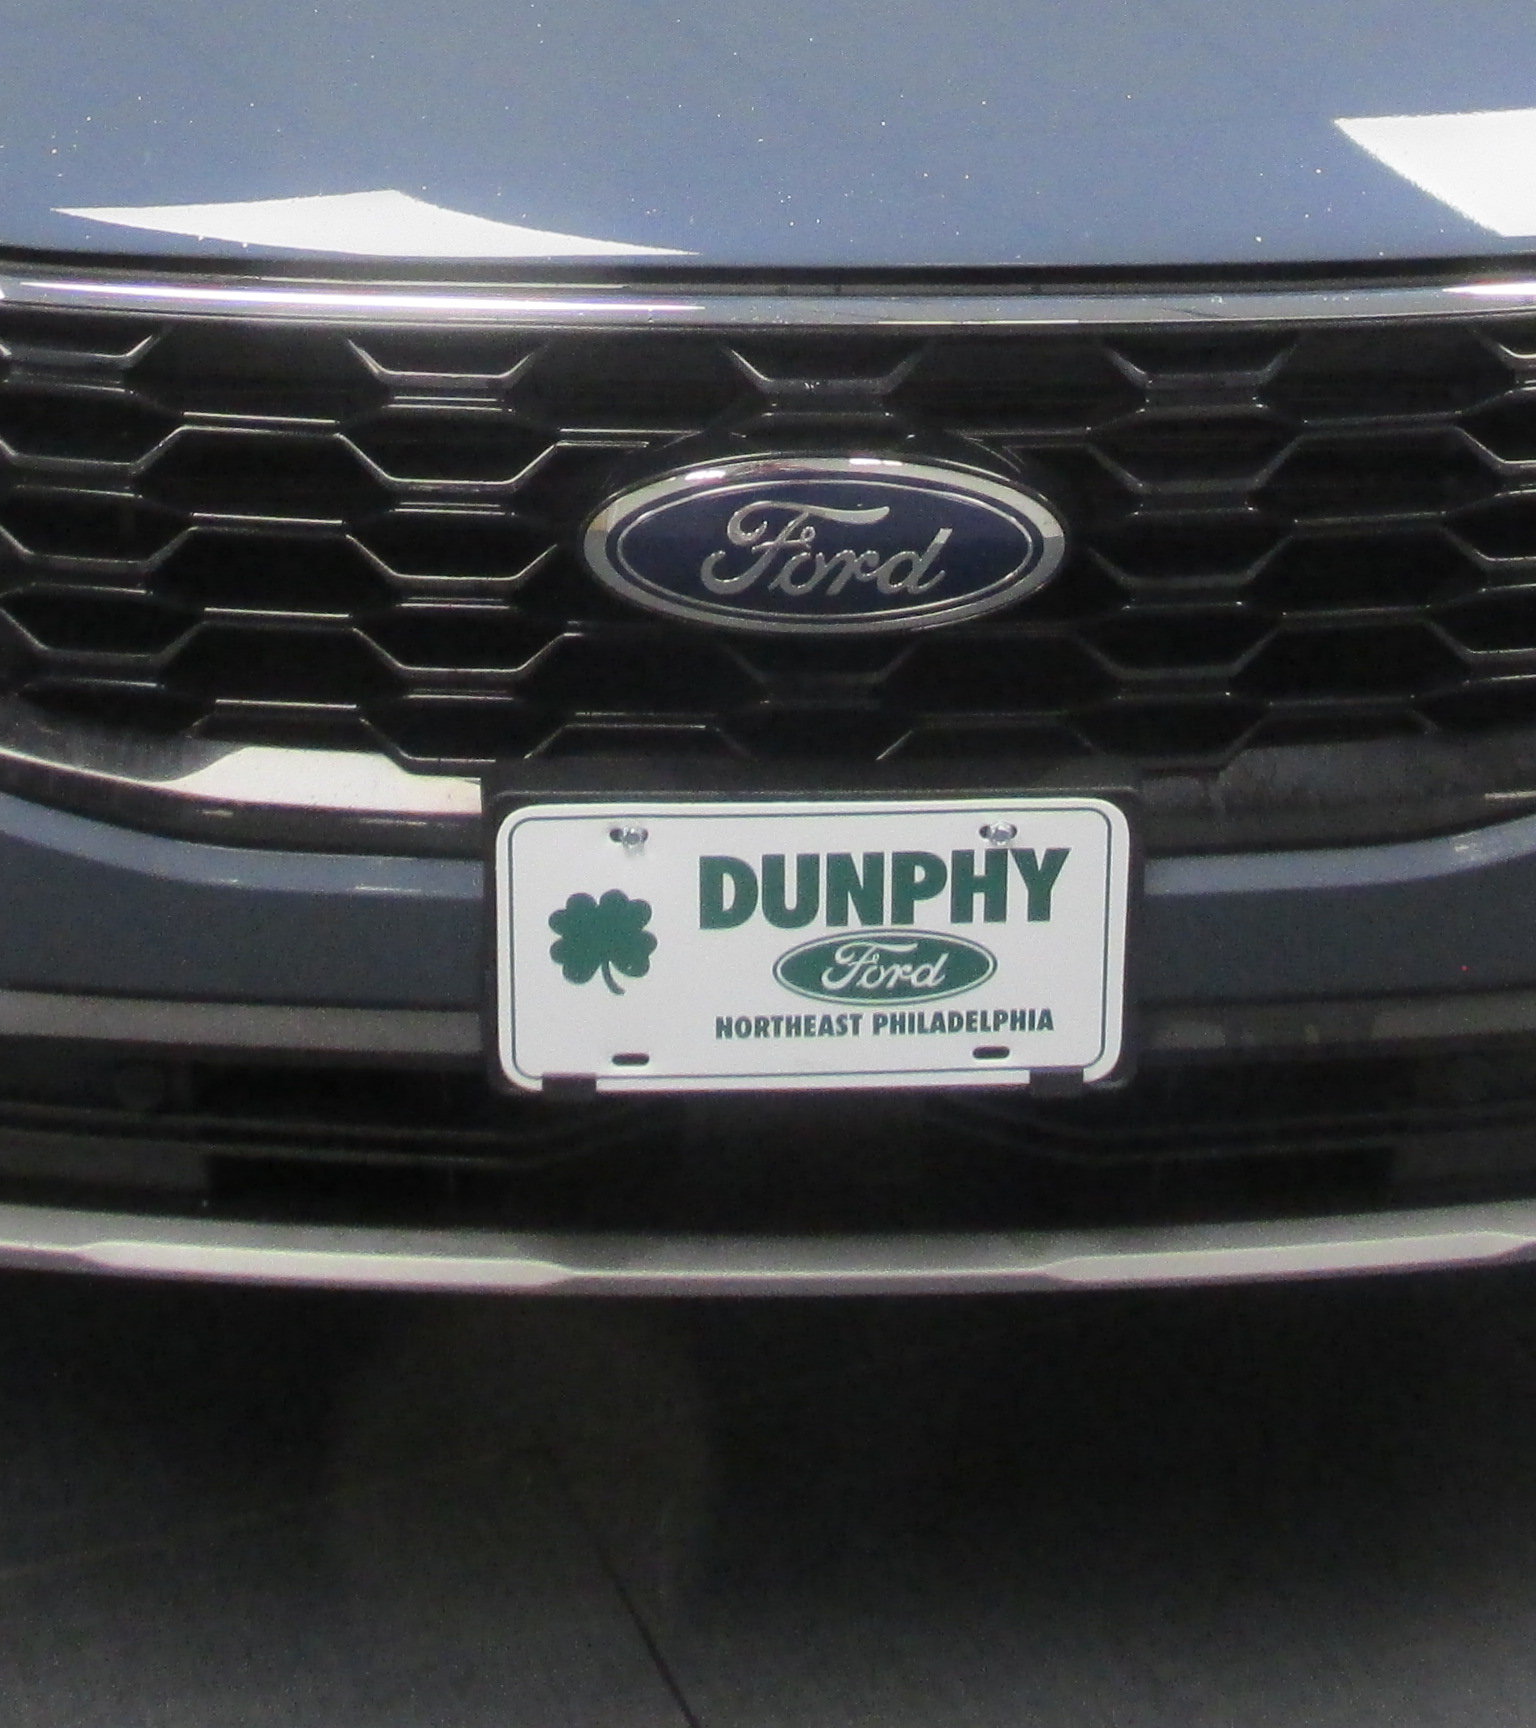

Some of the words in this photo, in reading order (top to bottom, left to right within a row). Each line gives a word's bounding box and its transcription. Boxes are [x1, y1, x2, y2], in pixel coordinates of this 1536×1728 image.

[701, 500, 953, 595] Ford
[698, 847, 1072, 930] DUNPHY
[822, 941, 950, 991] Ford
[715, 1013, 863, 1040] NORTHEAST
[872, 1007, 1055, 1037] PHILADELPHIA
